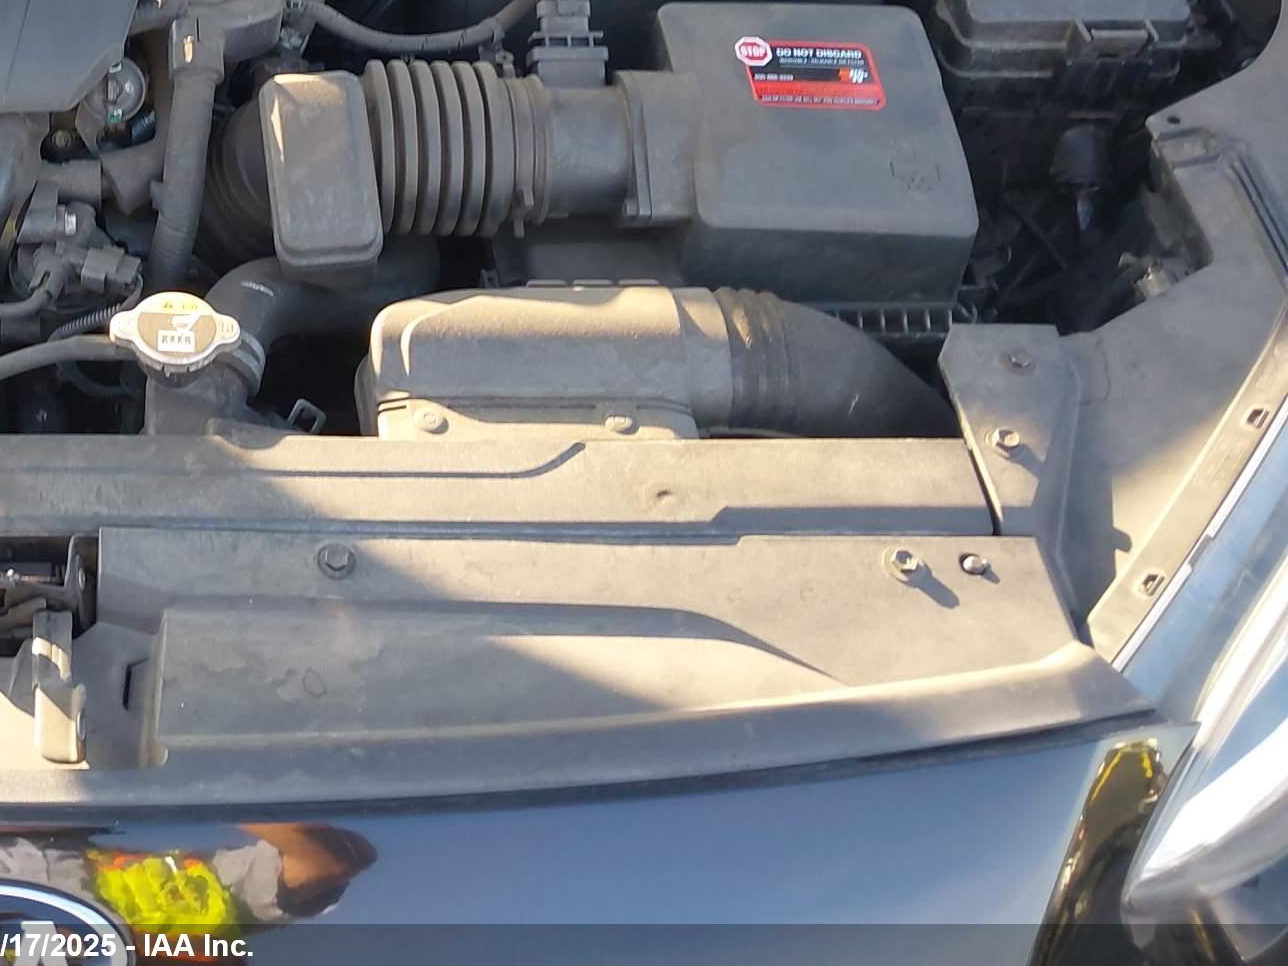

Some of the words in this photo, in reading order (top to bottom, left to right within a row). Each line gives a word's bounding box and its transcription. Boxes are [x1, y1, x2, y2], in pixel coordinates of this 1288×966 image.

[740, 45, 766, 57] STOP
[776, 47, 791, 58] DO
[793, 47, 814, 58] NOT
[816, 48, 862, 59] DISCARD
